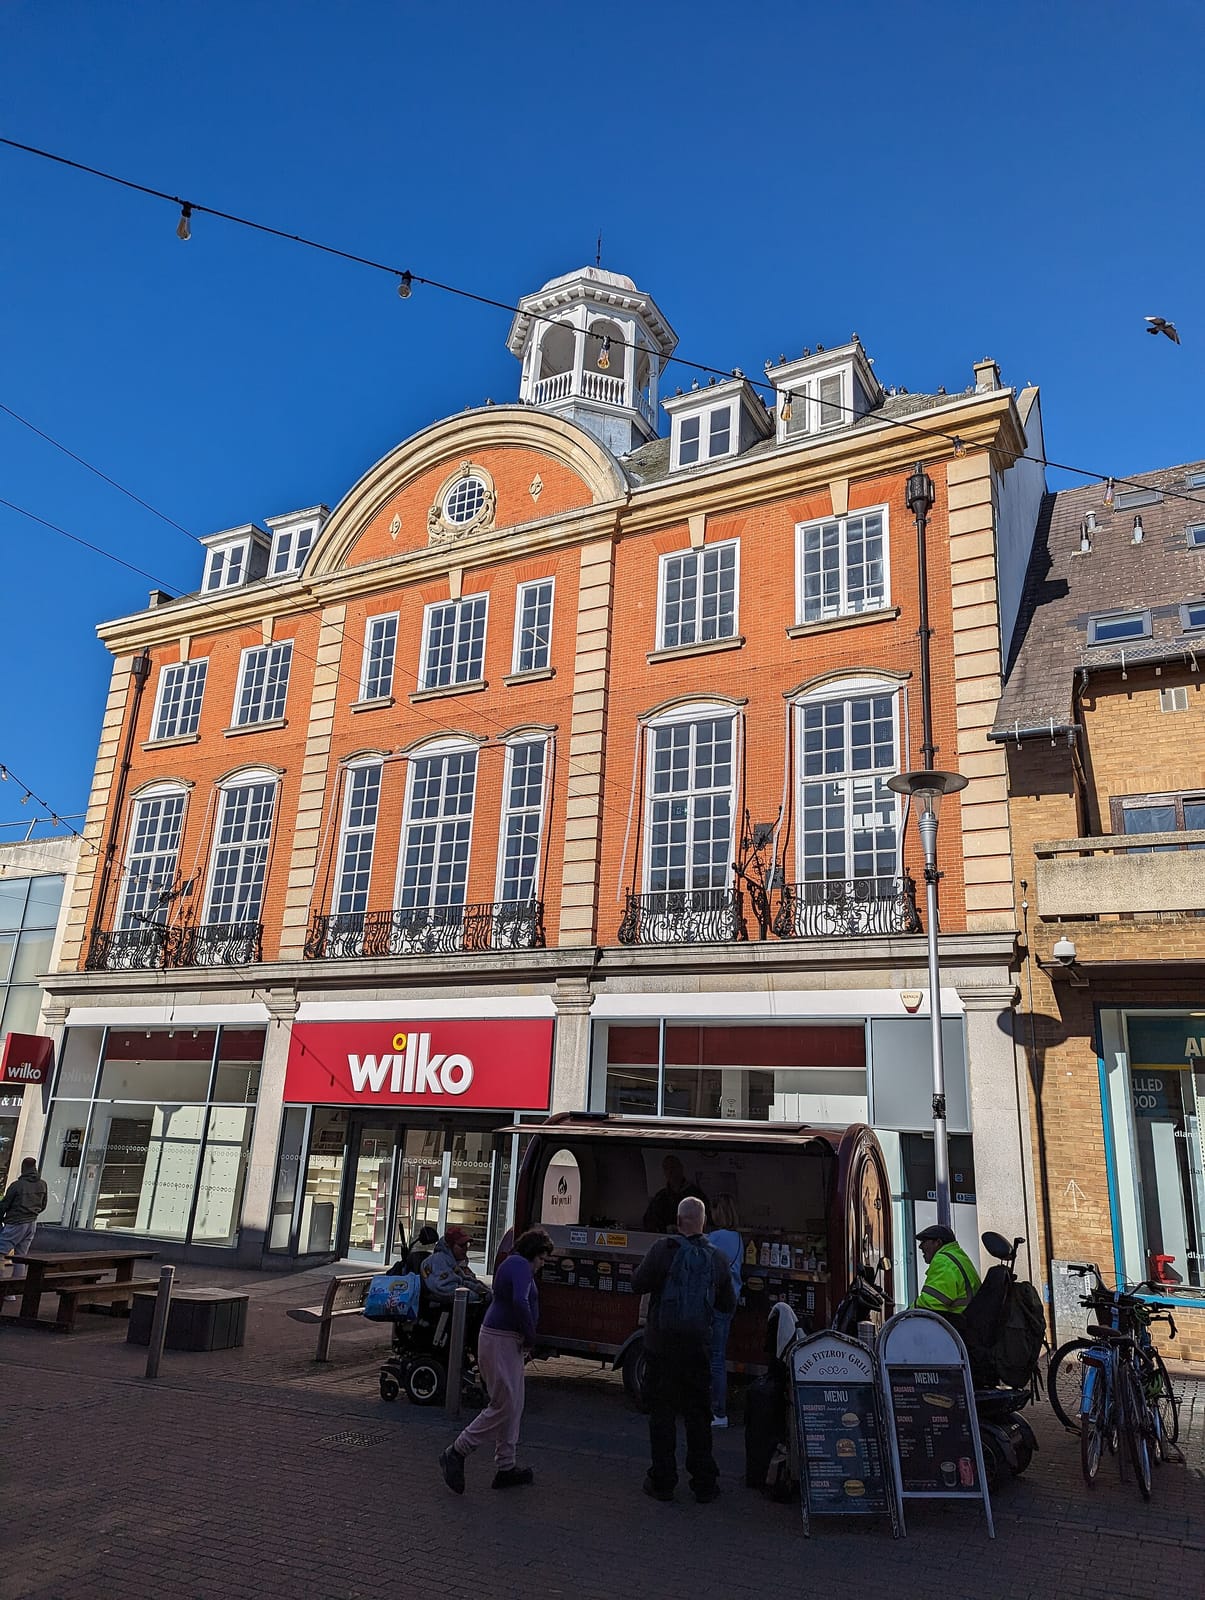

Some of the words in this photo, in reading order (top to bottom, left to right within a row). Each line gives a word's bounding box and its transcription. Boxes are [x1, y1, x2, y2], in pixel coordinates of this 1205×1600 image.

[390, 519, 401, 534] 19
[7, 1062, 42, 1080] wilko
[347, 1032, 475, 1095] wilko
[1, 1097, 10, 1107] &
[799, 1359, 813, 1375] THE
[812, 1350, 847, 1362] FITZROY
[848, 1353, 871, 1377] GRILL
[914, 1372, 939, 1385] MENU
[824, 1390, 849, 1402] MENU
